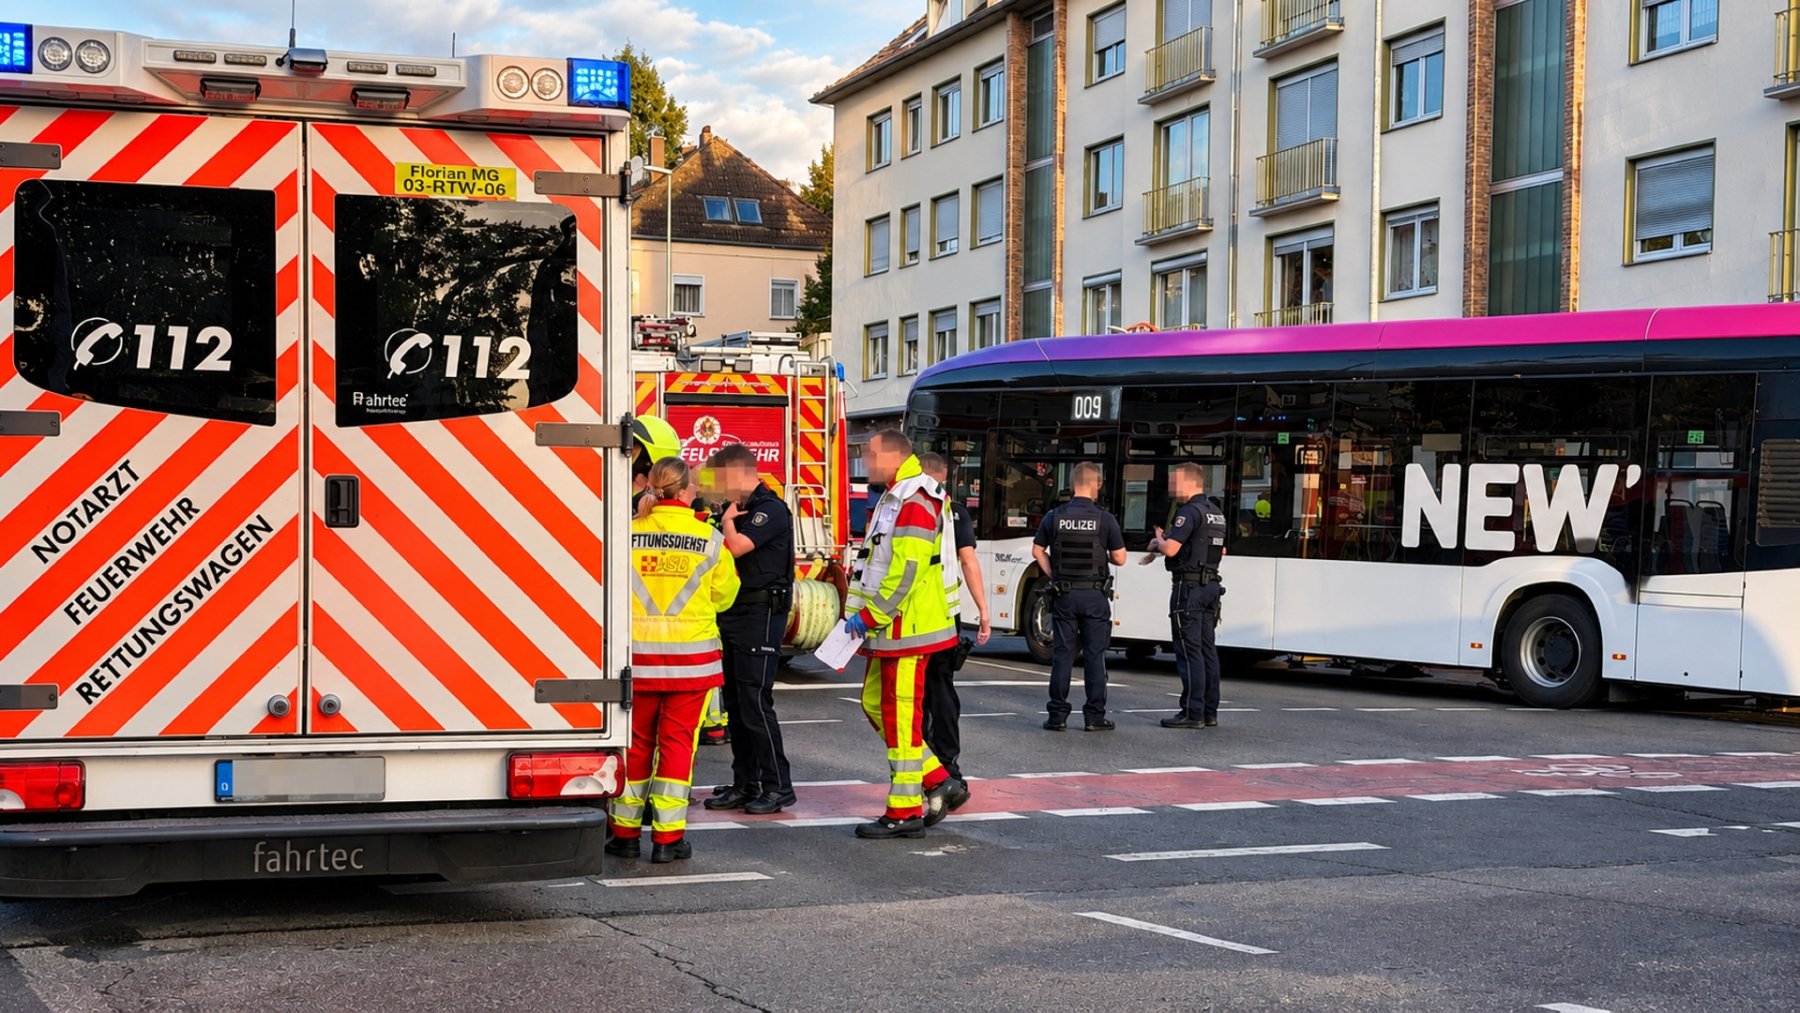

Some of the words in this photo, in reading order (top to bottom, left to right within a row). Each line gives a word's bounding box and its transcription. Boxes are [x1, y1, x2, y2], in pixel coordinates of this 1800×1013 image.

[403, 178, 506, 196] 03-RTW-06
[410, 165, 466, 180] Florian
[472, 168, 499, 181] MG
[134, 324, 232, 371] 112
[443, 335, 531, 379] 112
[1075, 395, 1101, 419] 009
[31, 459, 140, 564] NOTARZT
[1058, 518, 1097, 531] POLIZEI
[63, 497, 201, 626] FEUERWEHR
[75, 514, 274, 706] RETTUNGSWAGEN
[253, 840, 364, 873] fahrtec
